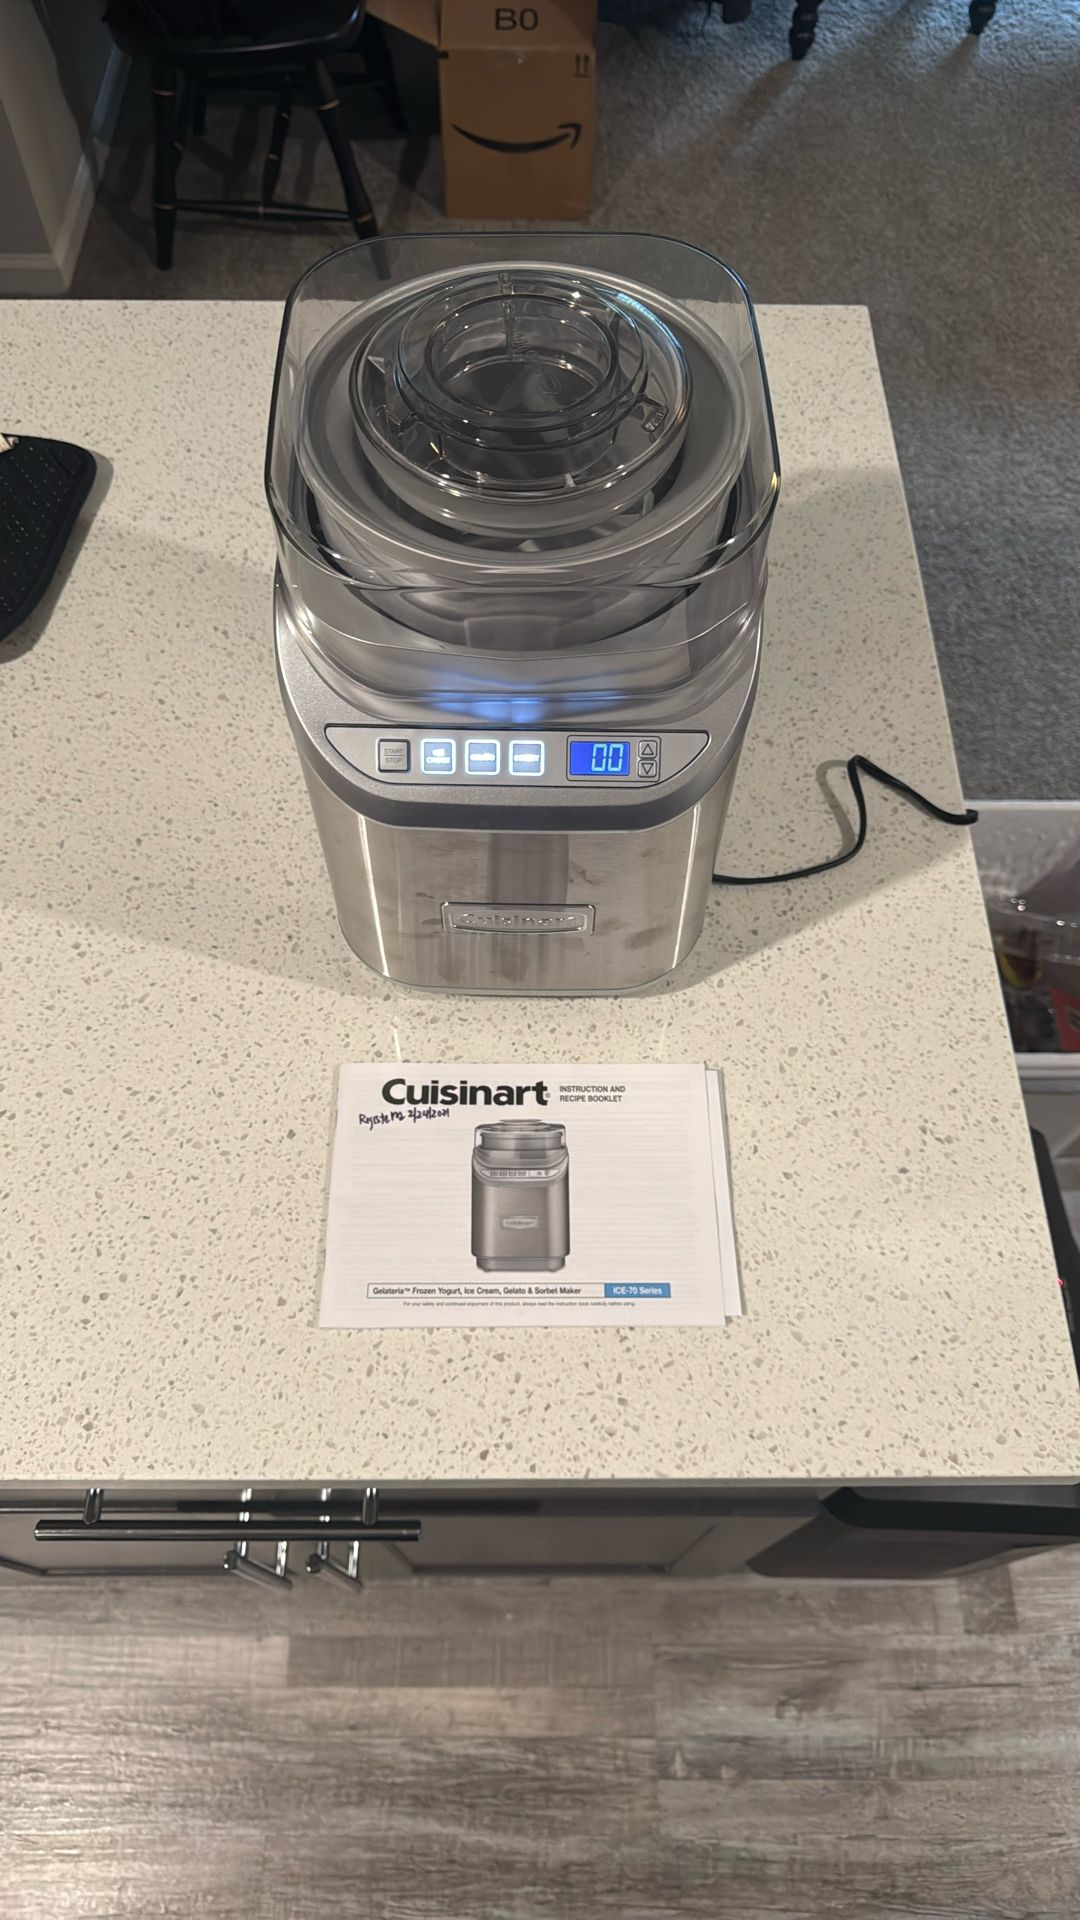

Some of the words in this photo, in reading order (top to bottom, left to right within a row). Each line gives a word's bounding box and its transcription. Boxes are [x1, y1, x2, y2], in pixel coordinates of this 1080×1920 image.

[591, 743, 624, 772] 00
[559, 1085, 608, 1093] INSTRUCTION
[610, 1085, 626, 1093] AND
[559, 1095, 586, 1103] RECIPE
[588, 1095, 622, 1103] BOOKLET
[412, 1287, 436, 1295] Frozen
[438, 1287, 463, 1296] Yogurt,
[464, 1287, 475, 1295] Ice
[476, 1287, 502, 1296] Cream,
[503, 1287, 526, 1295] Gelato
[528, 1287, 533, 1295] &
[534, 1287, 558, 1295] Sorbet
[560, 1287, 582, 1295] Maker
[612, 1286, 638, 1295] ICE-70
[639, 1287, 663, 1296] Series
